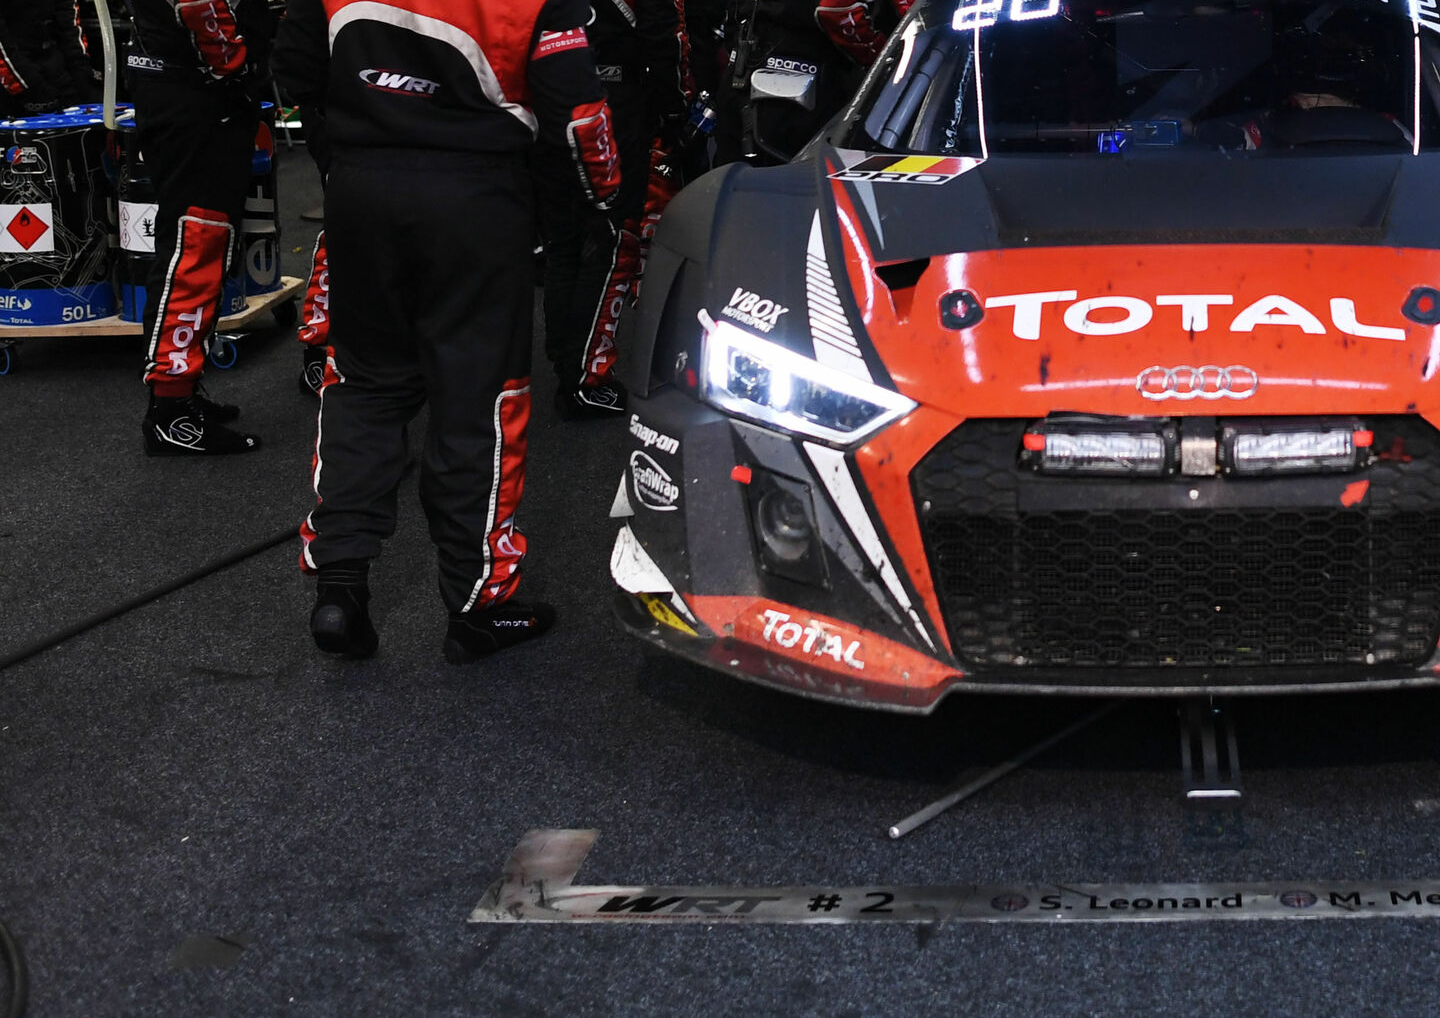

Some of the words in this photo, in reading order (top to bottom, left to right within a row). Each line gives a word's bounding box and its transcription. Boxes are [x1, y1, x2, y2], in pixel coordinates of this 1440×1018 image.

[127, 55, 164, 69] sparco
[766, 55, 818, 74] sparco
[377, 72, 441, 94] WRT
[831, 172, 948, 183] PRO
[728, 287, 790, 325] VBOX
[985, 289, 1406, 341] TOTAL
[590, 282, 631, 374] TOTAL
[629, 413, 680, 455] Snap-on
[763, 608, 865, 670] TOTAL
[597, 895, 783, 913] WRT
[807, 893, 842, 912] #
[861, 892, 895, 913] 2
[1039, 895, 1072, 910] S.
[1089, 893, 1243, 910] Leonard
[1329, 891, 1375, 907] M.
